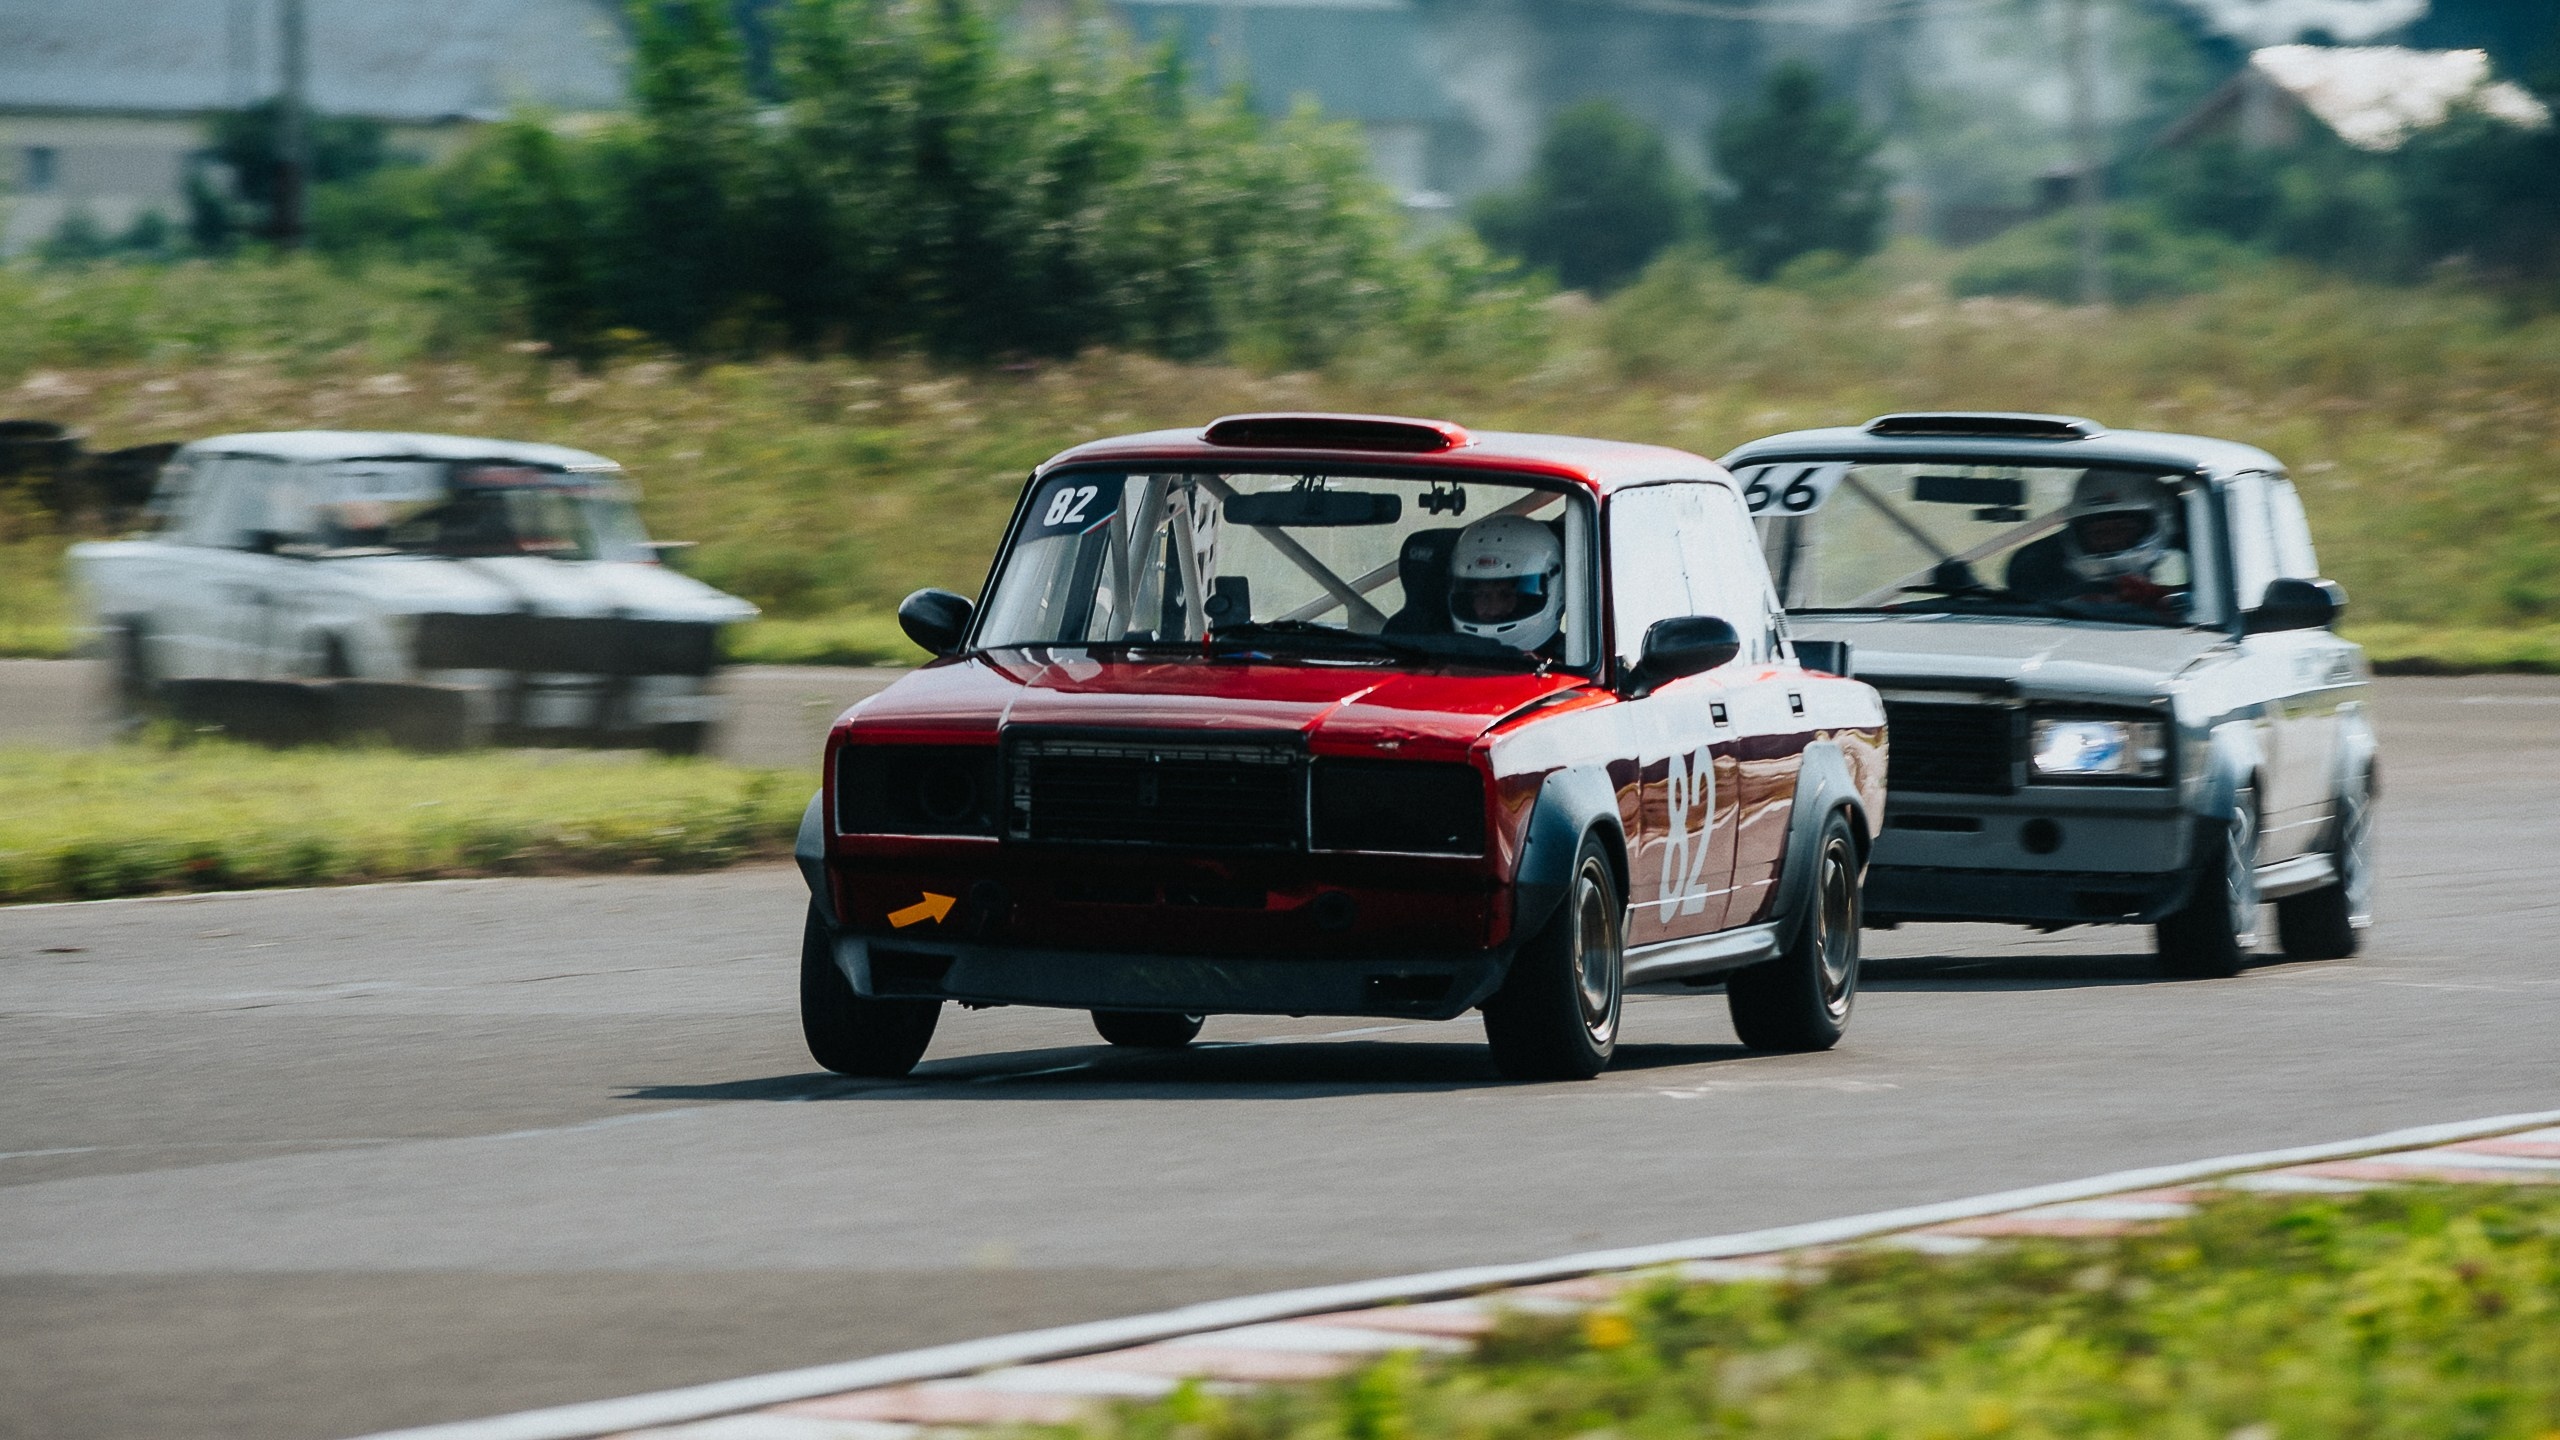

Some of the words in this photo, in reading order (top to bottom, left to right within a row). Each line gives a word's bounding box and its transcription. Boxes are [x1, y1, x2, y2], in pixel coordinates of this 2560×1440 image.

[1043, 485, 1099, 527] 82
[1744, 465, 1822, 513] 66
[1659, 744, 1717, 924] 82
